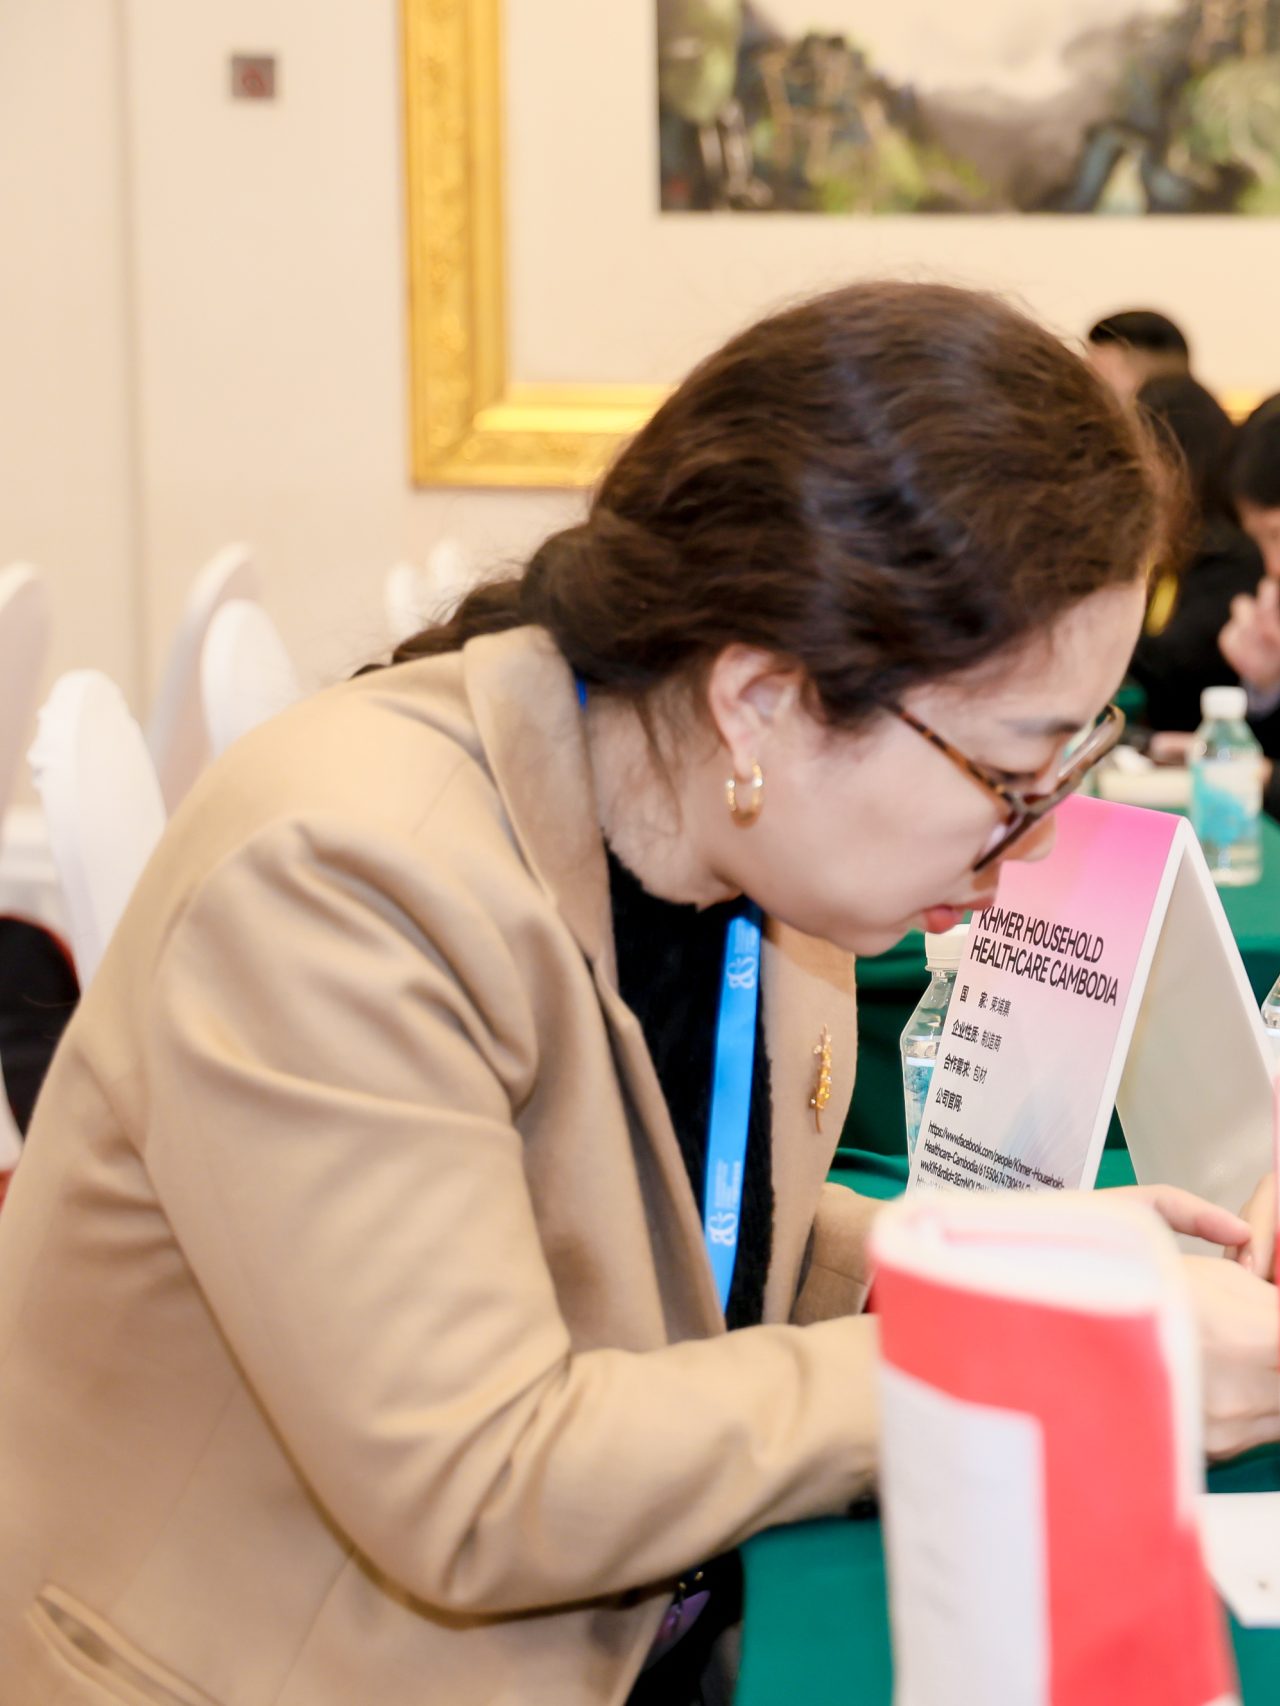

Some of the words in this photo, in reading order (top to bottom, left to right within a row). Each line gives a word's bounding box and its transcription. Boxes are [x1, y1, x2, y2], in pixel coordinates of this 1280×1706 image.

[978, 906, 1024, 941] KHMER
[1023, 917, 1104, 963] HOUSEHOLD
[970, 935, 1051, 983] HEALTHCARE
[1050, 960, 1119, 1006] CAMBODIA
